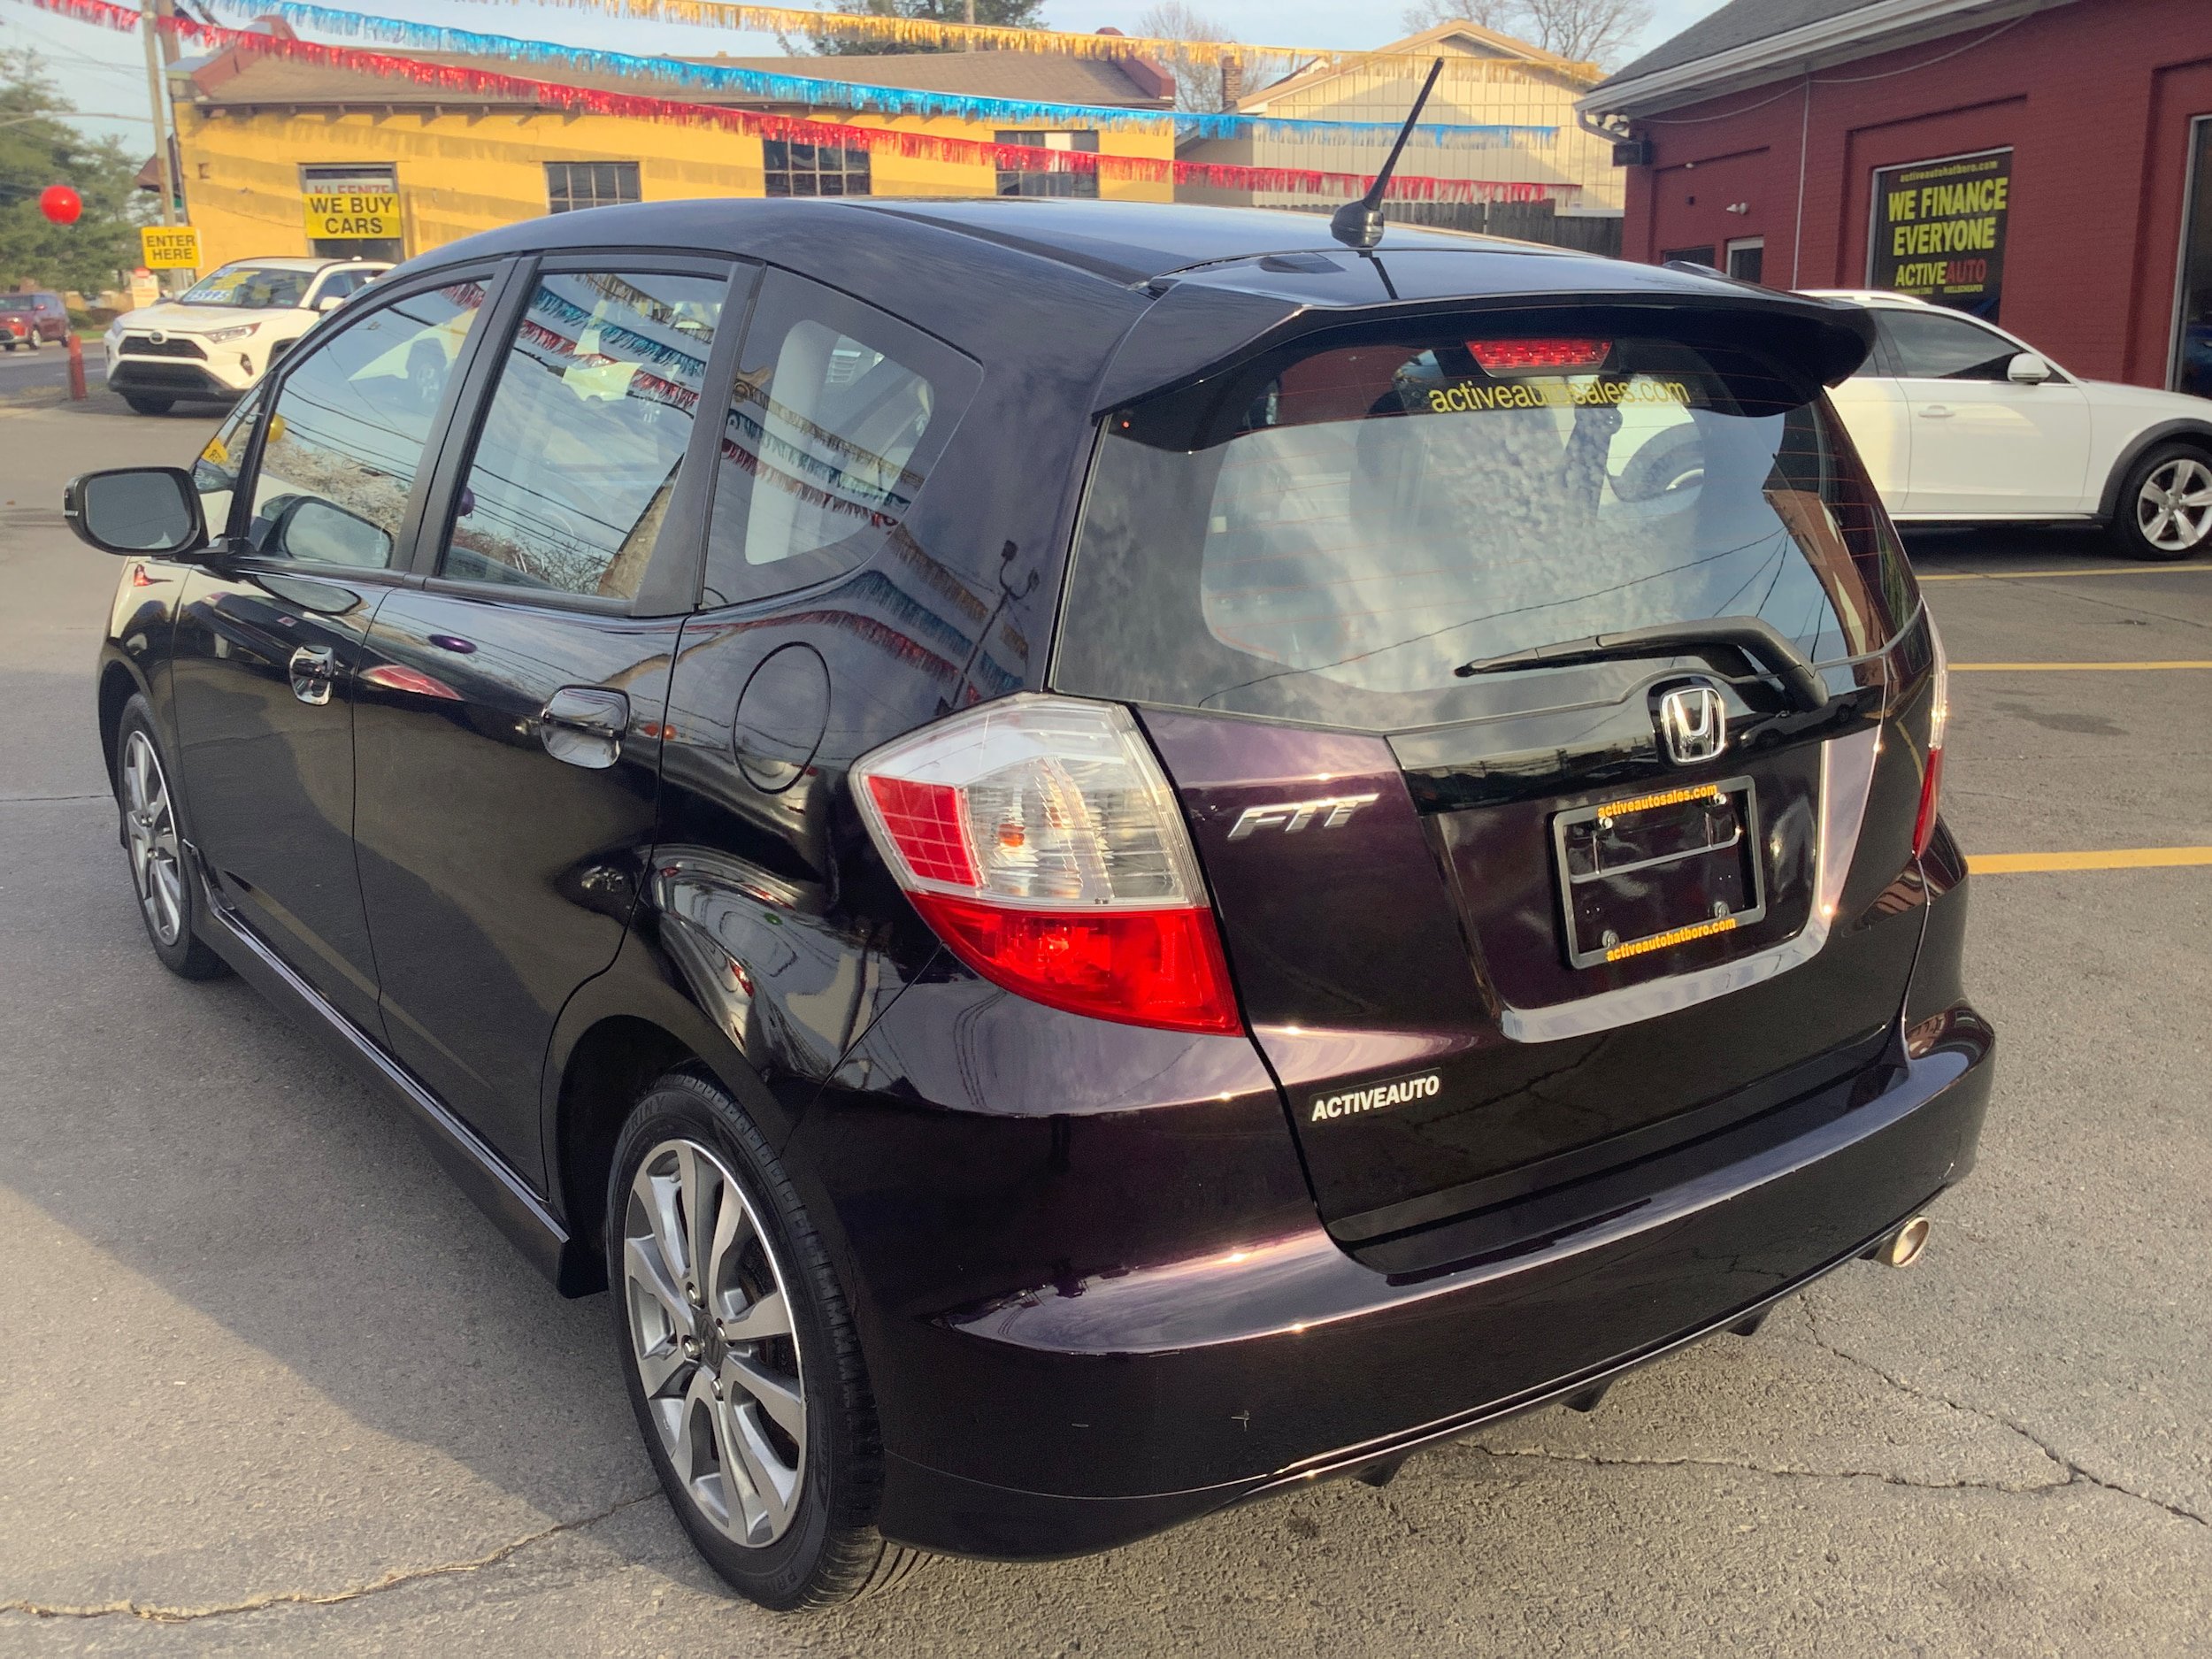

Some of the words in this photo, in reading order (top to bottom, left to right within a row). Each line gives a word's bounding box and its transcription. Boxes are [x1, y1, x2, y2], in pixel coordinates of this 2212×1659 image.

[310, 196, 343, 214] WE
[350, 196, 392, 213] BUY
[1888, 190, 1917, 222] WE
[1921, 177, 2008, 219] FINANCE
[146, 234, 195, 247] ENTER
[325, 217, 383, 234] CARS
[1893, 217, 1996, 256] EVERYONE
[151, 248, 193, 260] HERE
[1428, 380, 1691, 413] activeausales.com
[1227, 794, 1380, 841] FIT
[1597, 784, 1718, 818] activeautosales.com
[1606, 918, 1737, 962] activeautohatboro.com
[1311, 1075, 1440, 1122] ACTIVEAUTO
